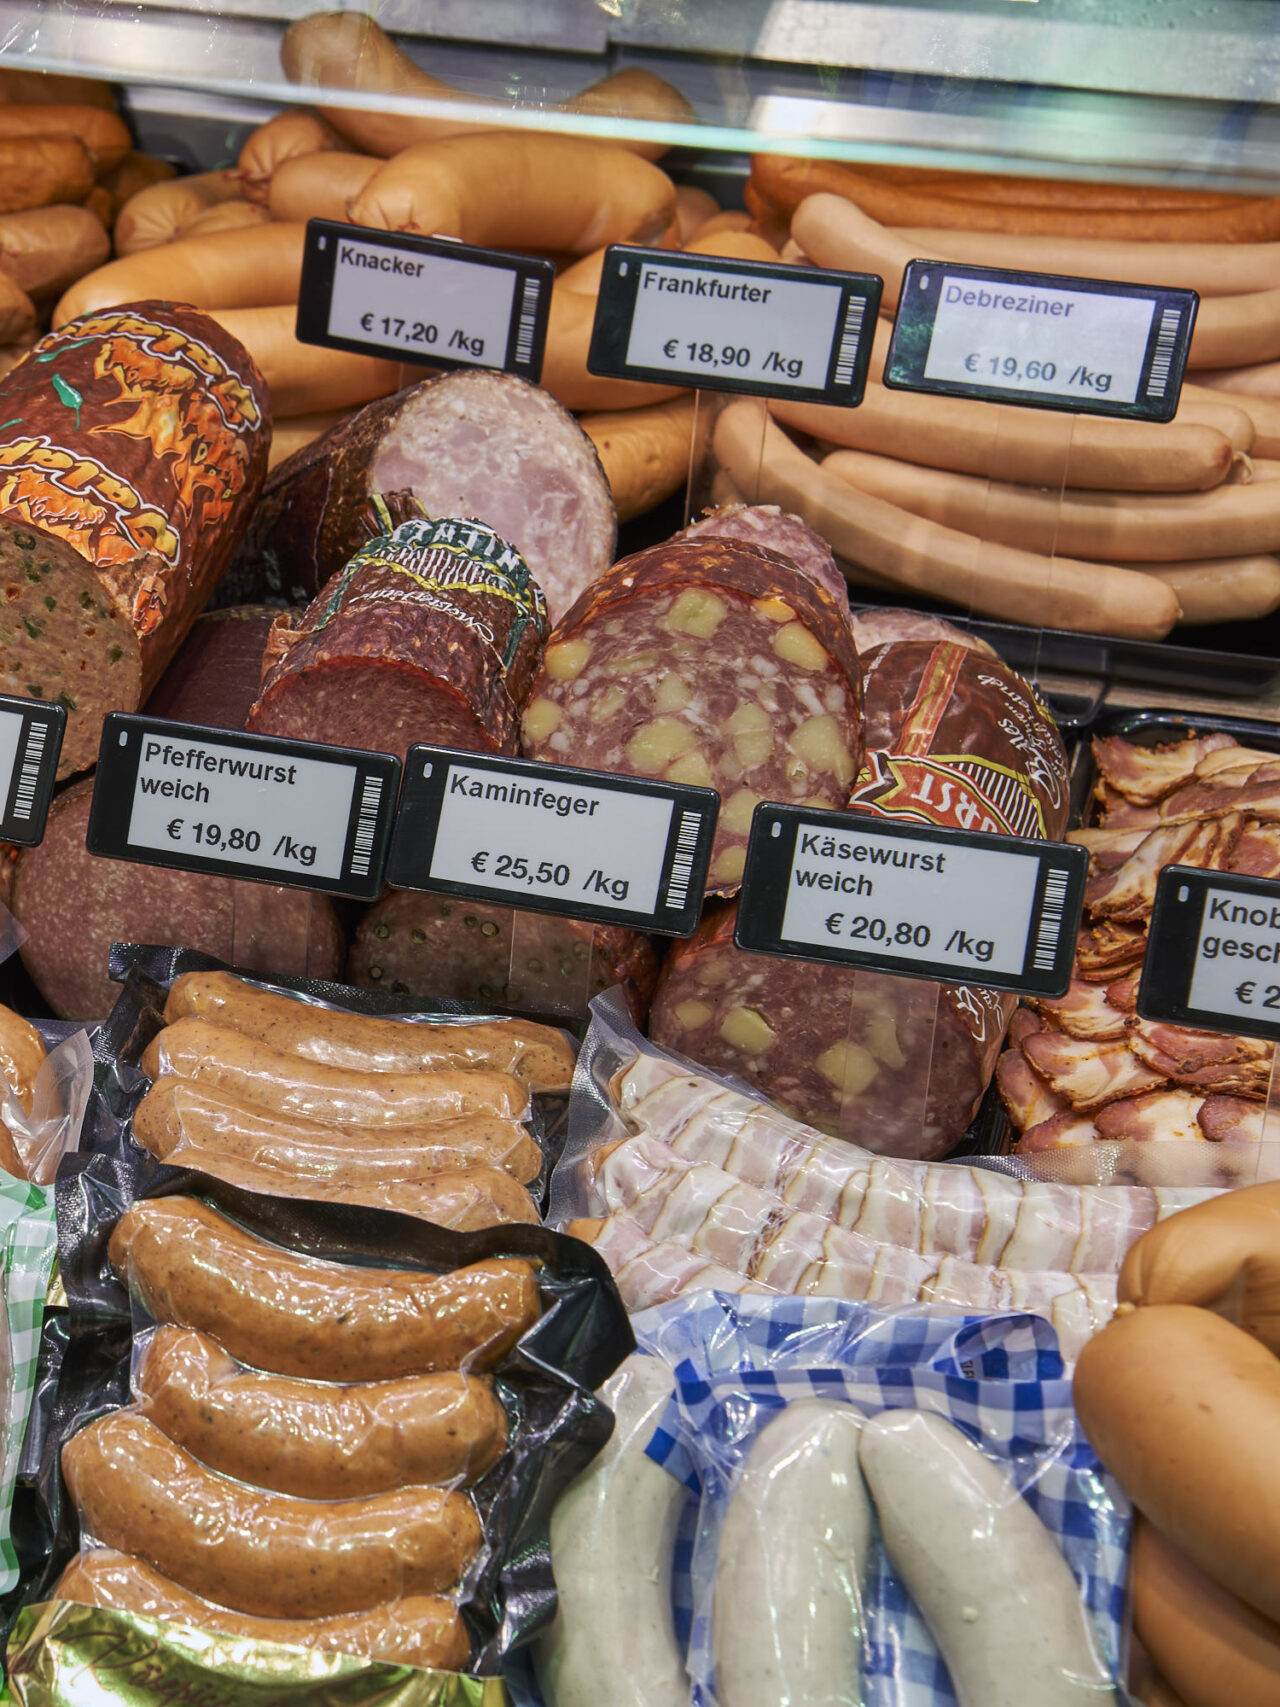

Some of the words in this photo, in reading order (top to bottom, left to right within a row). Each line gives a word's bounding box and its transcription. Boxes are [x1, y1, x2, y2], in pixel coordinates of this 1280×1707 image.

[340, 246, 424, 279] Knacker
[643, 271, 773, 304] Frankfurter
[945, 285, 1075, 318] Debreziner
[360, 313, 374, 332] €
[381, 316, 439, 345] 17,20
[447, 329, 485, 358] /kg
[663, 339, 679, 359] €
[686, 342, 751, 368] 18,90
[762, 351, 804, 379] /kg
[964, 353, 980, 373] €
[990, 356, 1057, 382] 19,60
[1067, 366, 1113, 394] /kg
[144, 741, 298, 786] Pfefferwurst
[139, 777, 210, 804] weich
[450, 773, 601, 818] Kaminfeger
[166, 818, 184, 841] €
[192, 822, 262, 853] 19,80
[271, 835, 318, 867] /kg
[800, 833, 947, 874] Käsewurst
[470, 850, 490, 874] €
[494, 854, 571, 887] 25,50
[581, 869, 630, 902] /kg
[794, 870, 873, 897] weich
[825, 912, 845, 936] €
[849, 915, 932, 948] 20,80
[943, 929, 996, 963] /kg
[1234, 980, 1258, 1005] €
